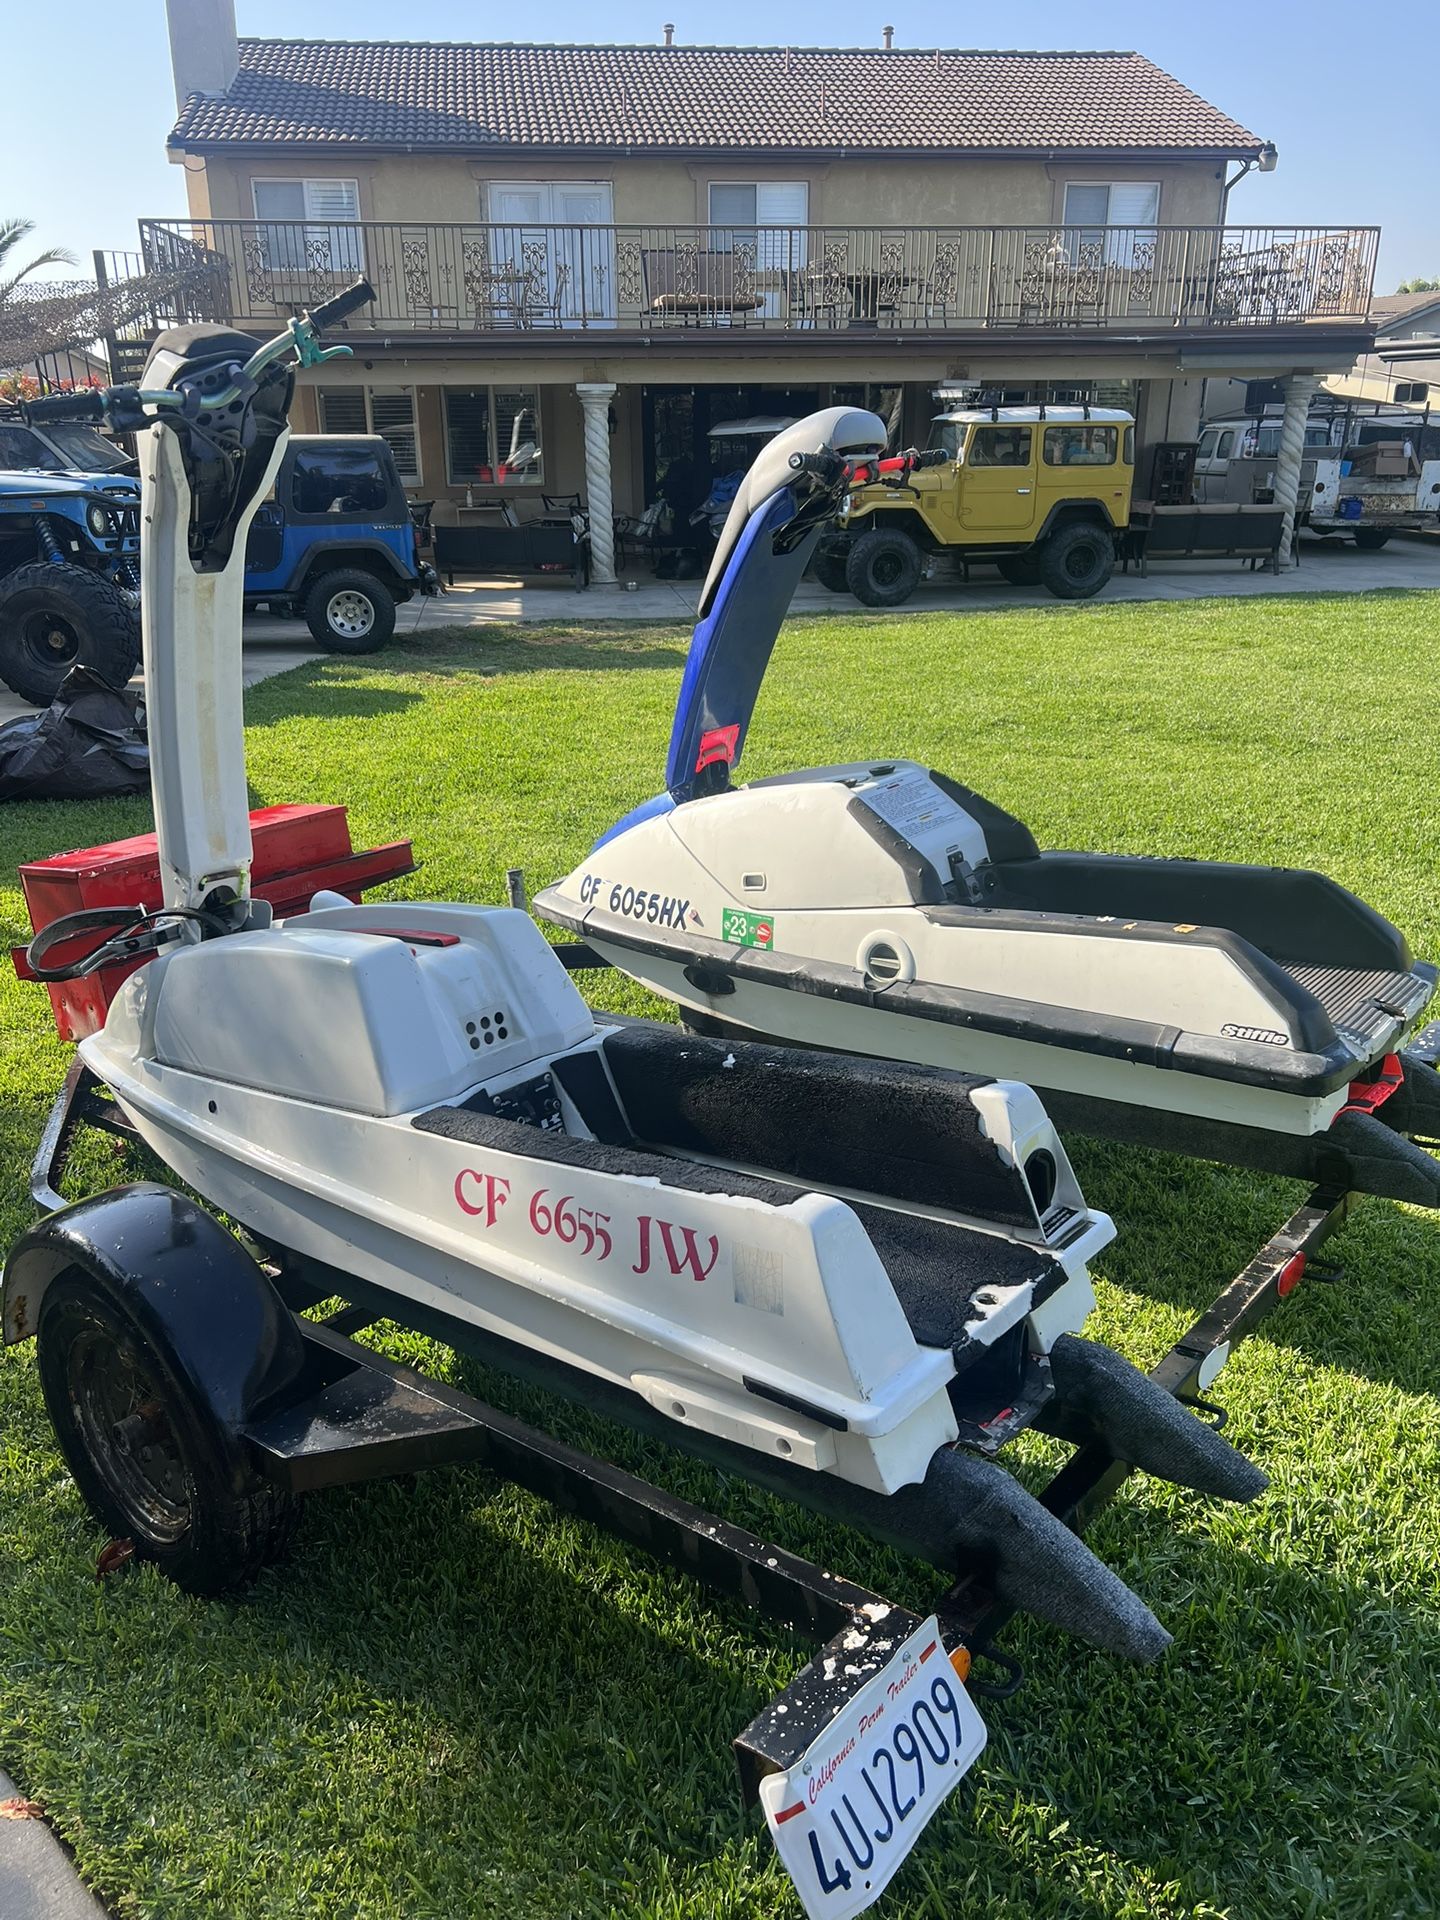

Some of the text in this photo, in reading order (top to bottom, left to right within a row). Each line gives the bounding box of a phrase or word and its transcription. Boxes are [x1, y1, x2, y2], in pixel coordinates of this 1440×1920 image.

[580, 874, 690, 931] CF 6055HX
[730, 915, 747, 937] 23
[1221, 1024, 1288, 1045] Stiffle
[454, 1168, 719, 1282] CF 6655 JW
[808, 1662, 919, 1805] California Perm Trailer
[808, 1677, 962, 1895] 4UJ2909
